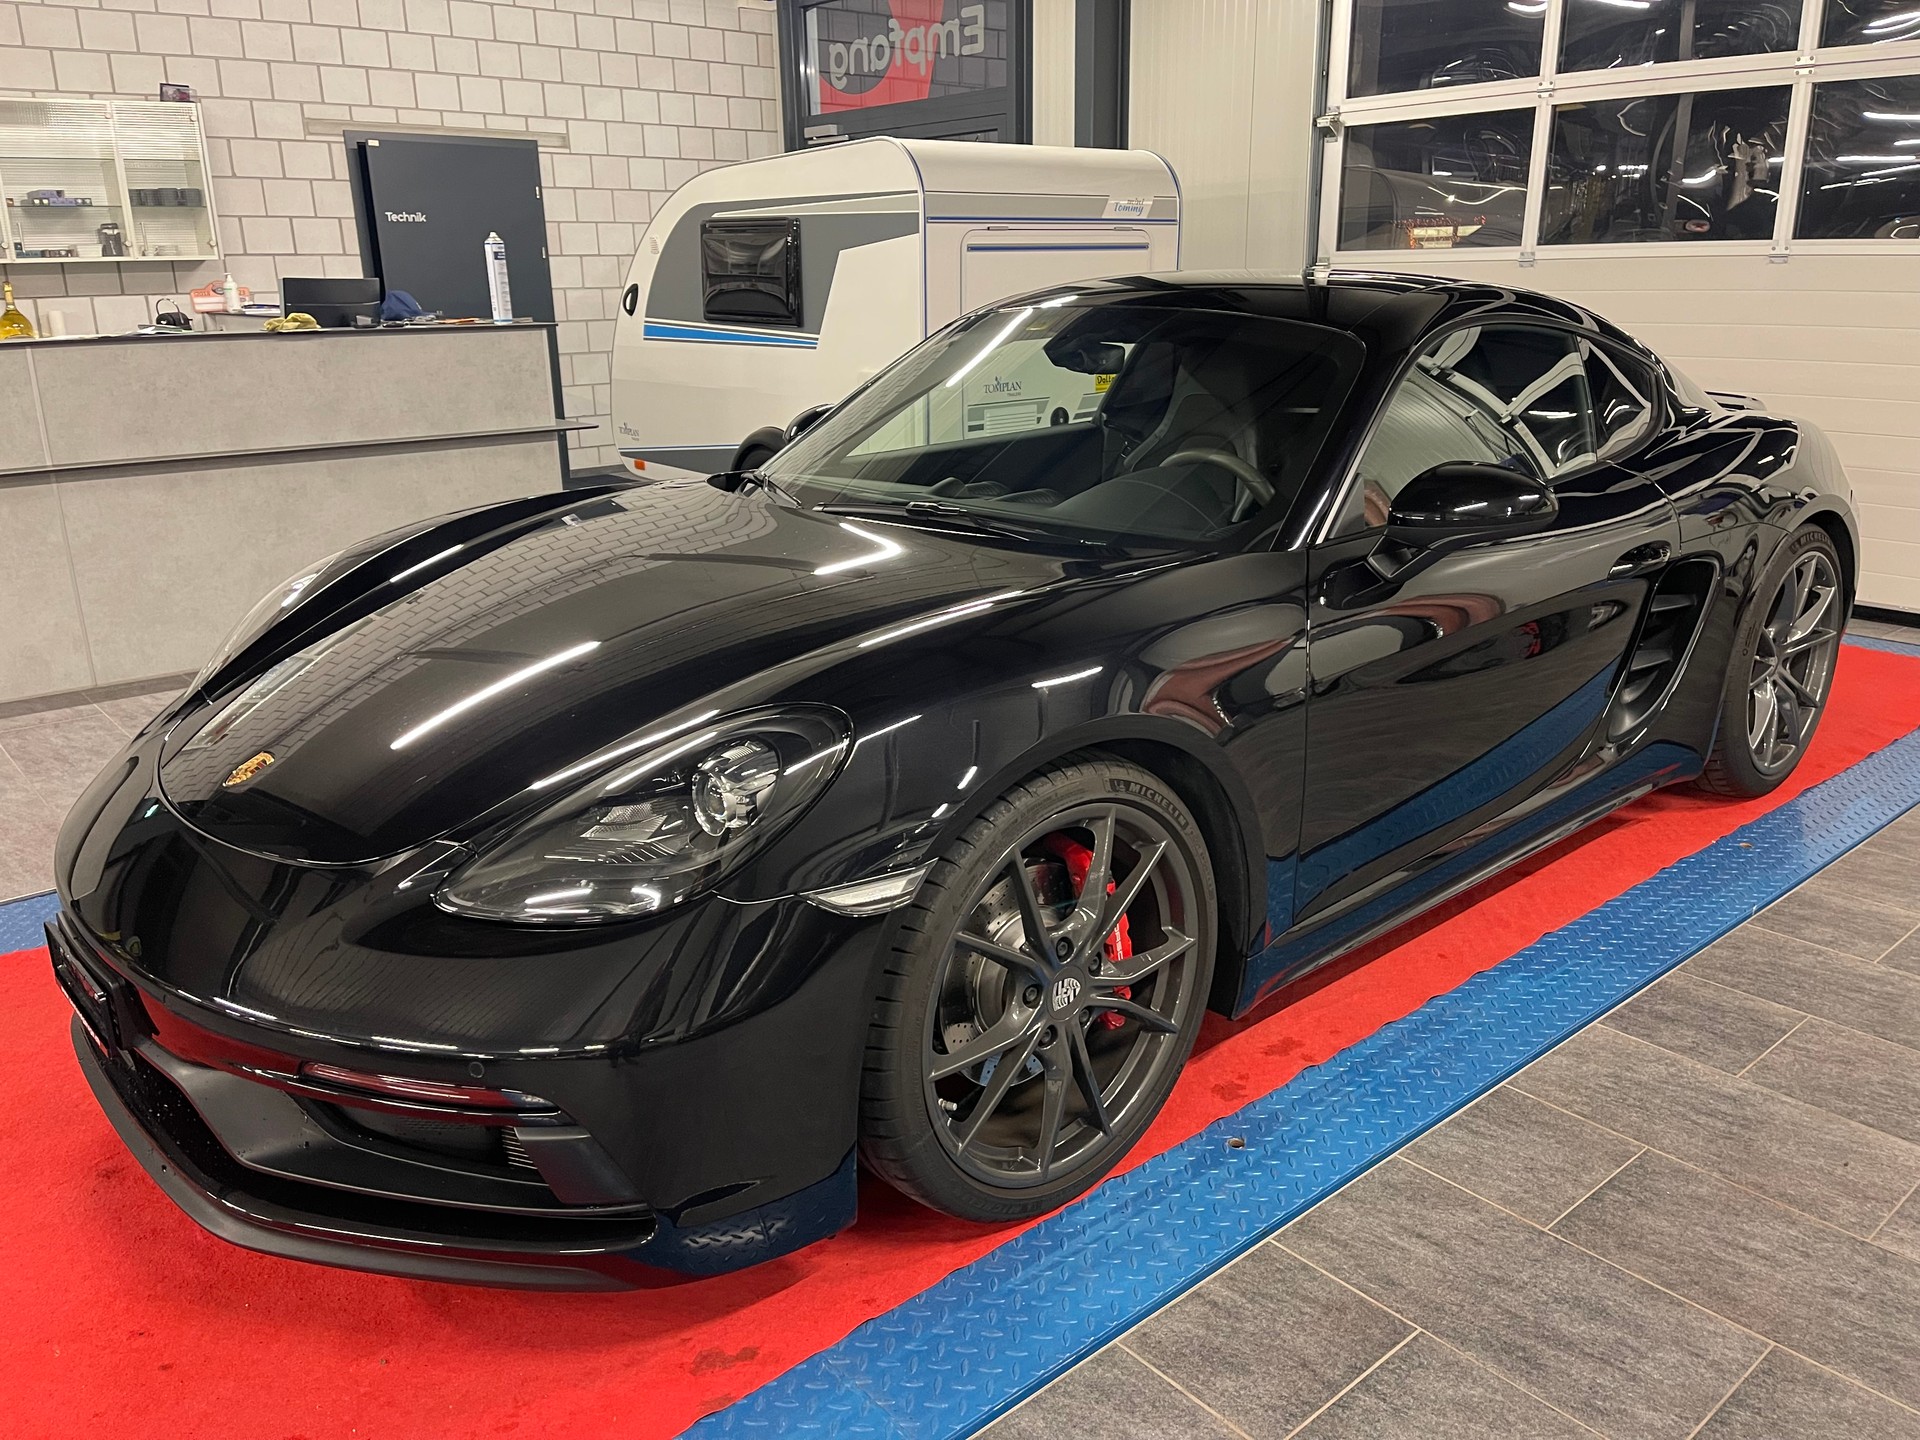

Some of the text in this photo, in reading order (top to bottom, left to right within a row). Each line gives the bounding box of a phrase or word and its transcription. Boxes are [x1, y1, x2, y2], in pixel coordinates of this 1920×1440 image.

[1113, 202, 1144, 216] Tommy
[384, 211, 427, 222] Technik
[983, 381, 1022, 393] TOMPLAN
[1129, 782, 1188, 827] MICHELIN
[1113, 923, 1124, 961] ORSC
